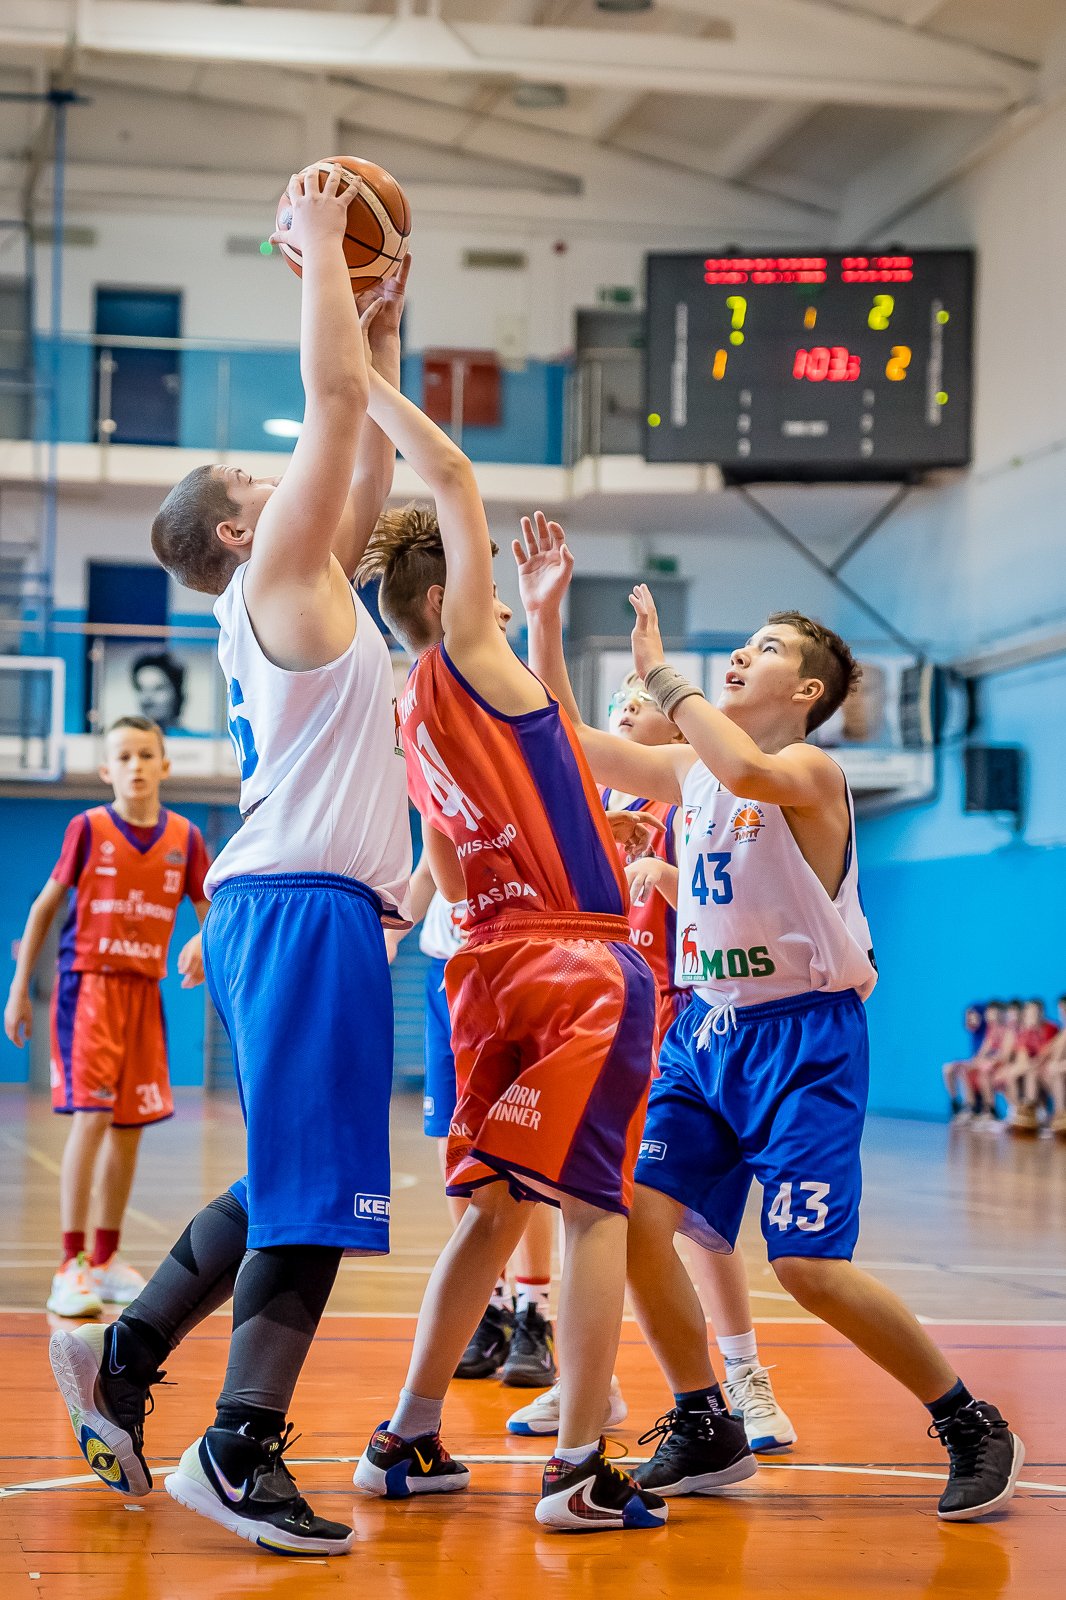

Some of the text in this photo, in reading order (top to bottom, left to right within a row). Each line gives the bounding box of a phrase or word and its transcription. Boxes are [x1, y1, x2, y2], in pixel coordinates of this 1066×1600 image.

[692, 852, 734, 905] 43
[700, 946, 776, 981] MOS
[768, 1182, 830, 1232] 43
